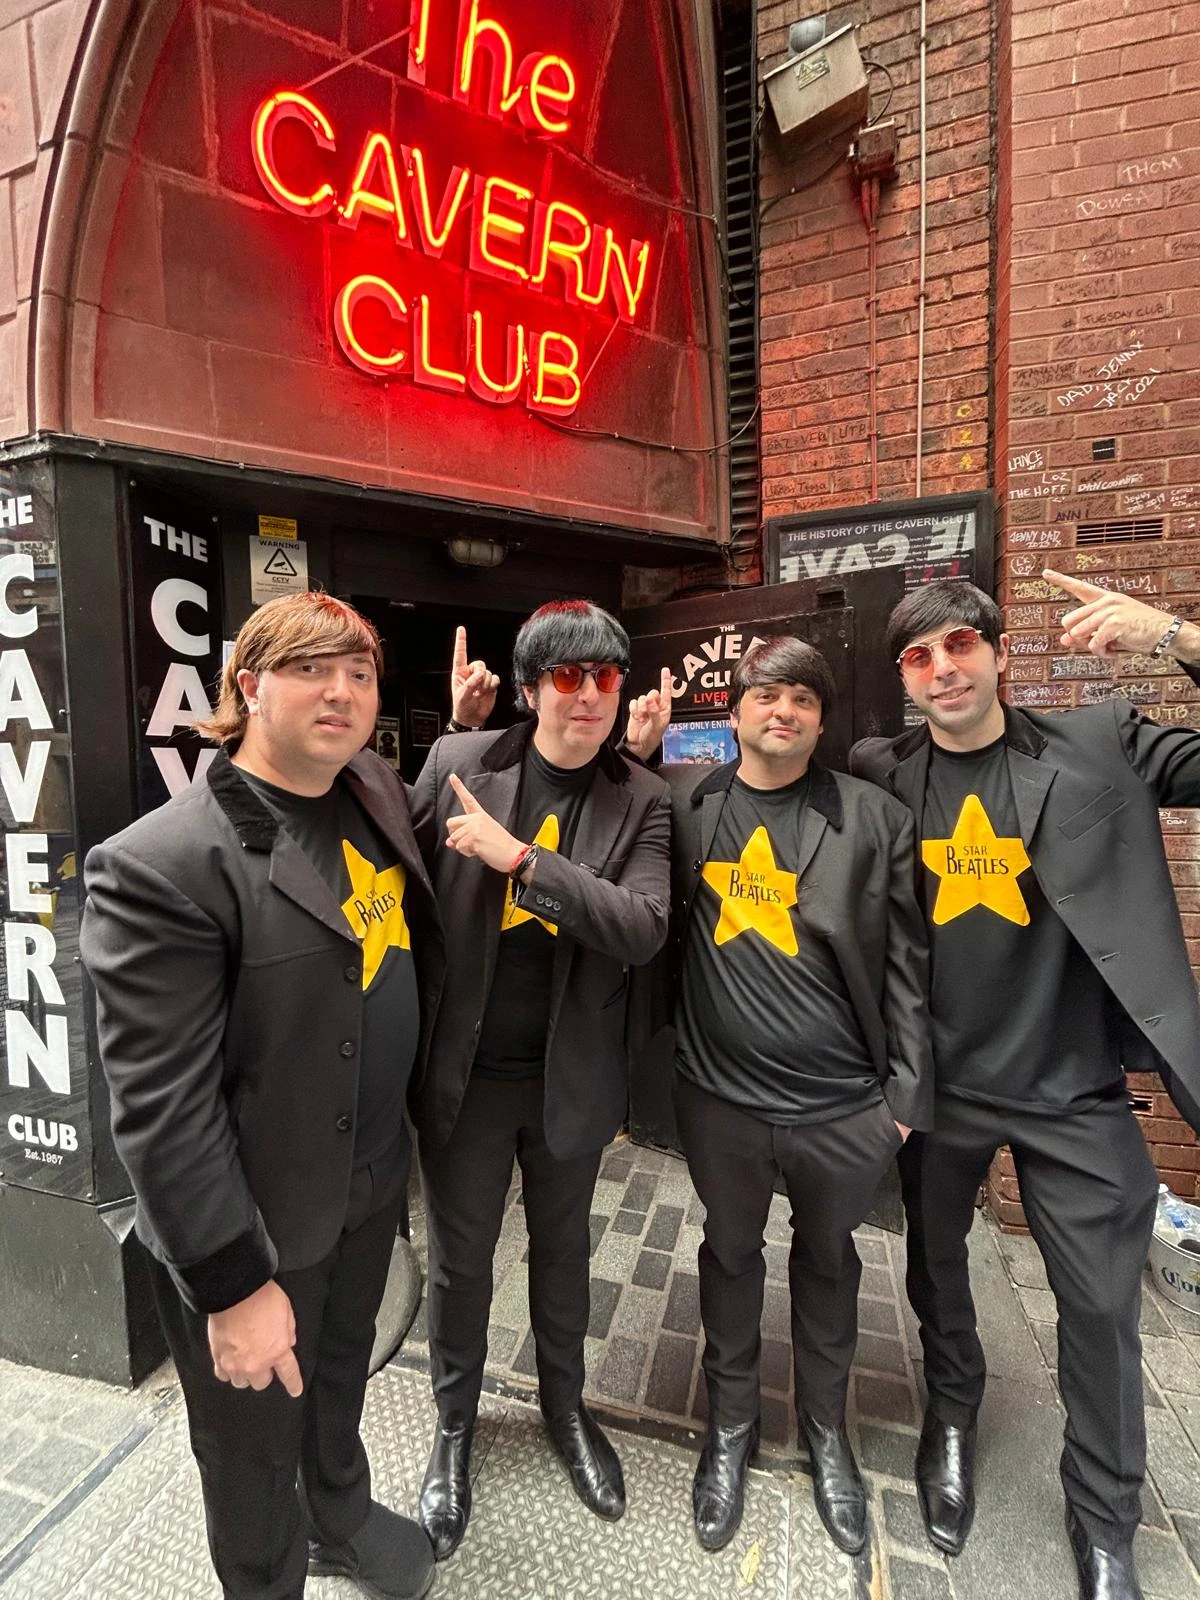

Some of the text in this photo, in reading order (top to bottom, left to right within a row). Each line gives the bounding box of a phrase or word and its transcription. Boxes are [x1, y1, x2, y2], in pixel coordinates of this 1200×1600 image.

[252, 92, 649, 317] CAVERN
[334, 275, 581, 416] CLUB
[143, 516, 209, 563] THE
[788, 514, 973, 542] THE HISTORY OF THE CAVERN CLUB
[259, 539, 300, 551] WARNING
[272, 576, 291, 584] CCTV
[720, 624, 736, 633] THE
[668, 722, 688, 732] CASH
[690, 721, 710, 730] ONLY
[946, 845, 1010, 880] BEATLES
[963, 845, 988, 856] STAR
[729, 868, 782, 906] BEATLES
[746, 871, 766, 883] STAR
[8, 1114, 78, 1151] CLUB
